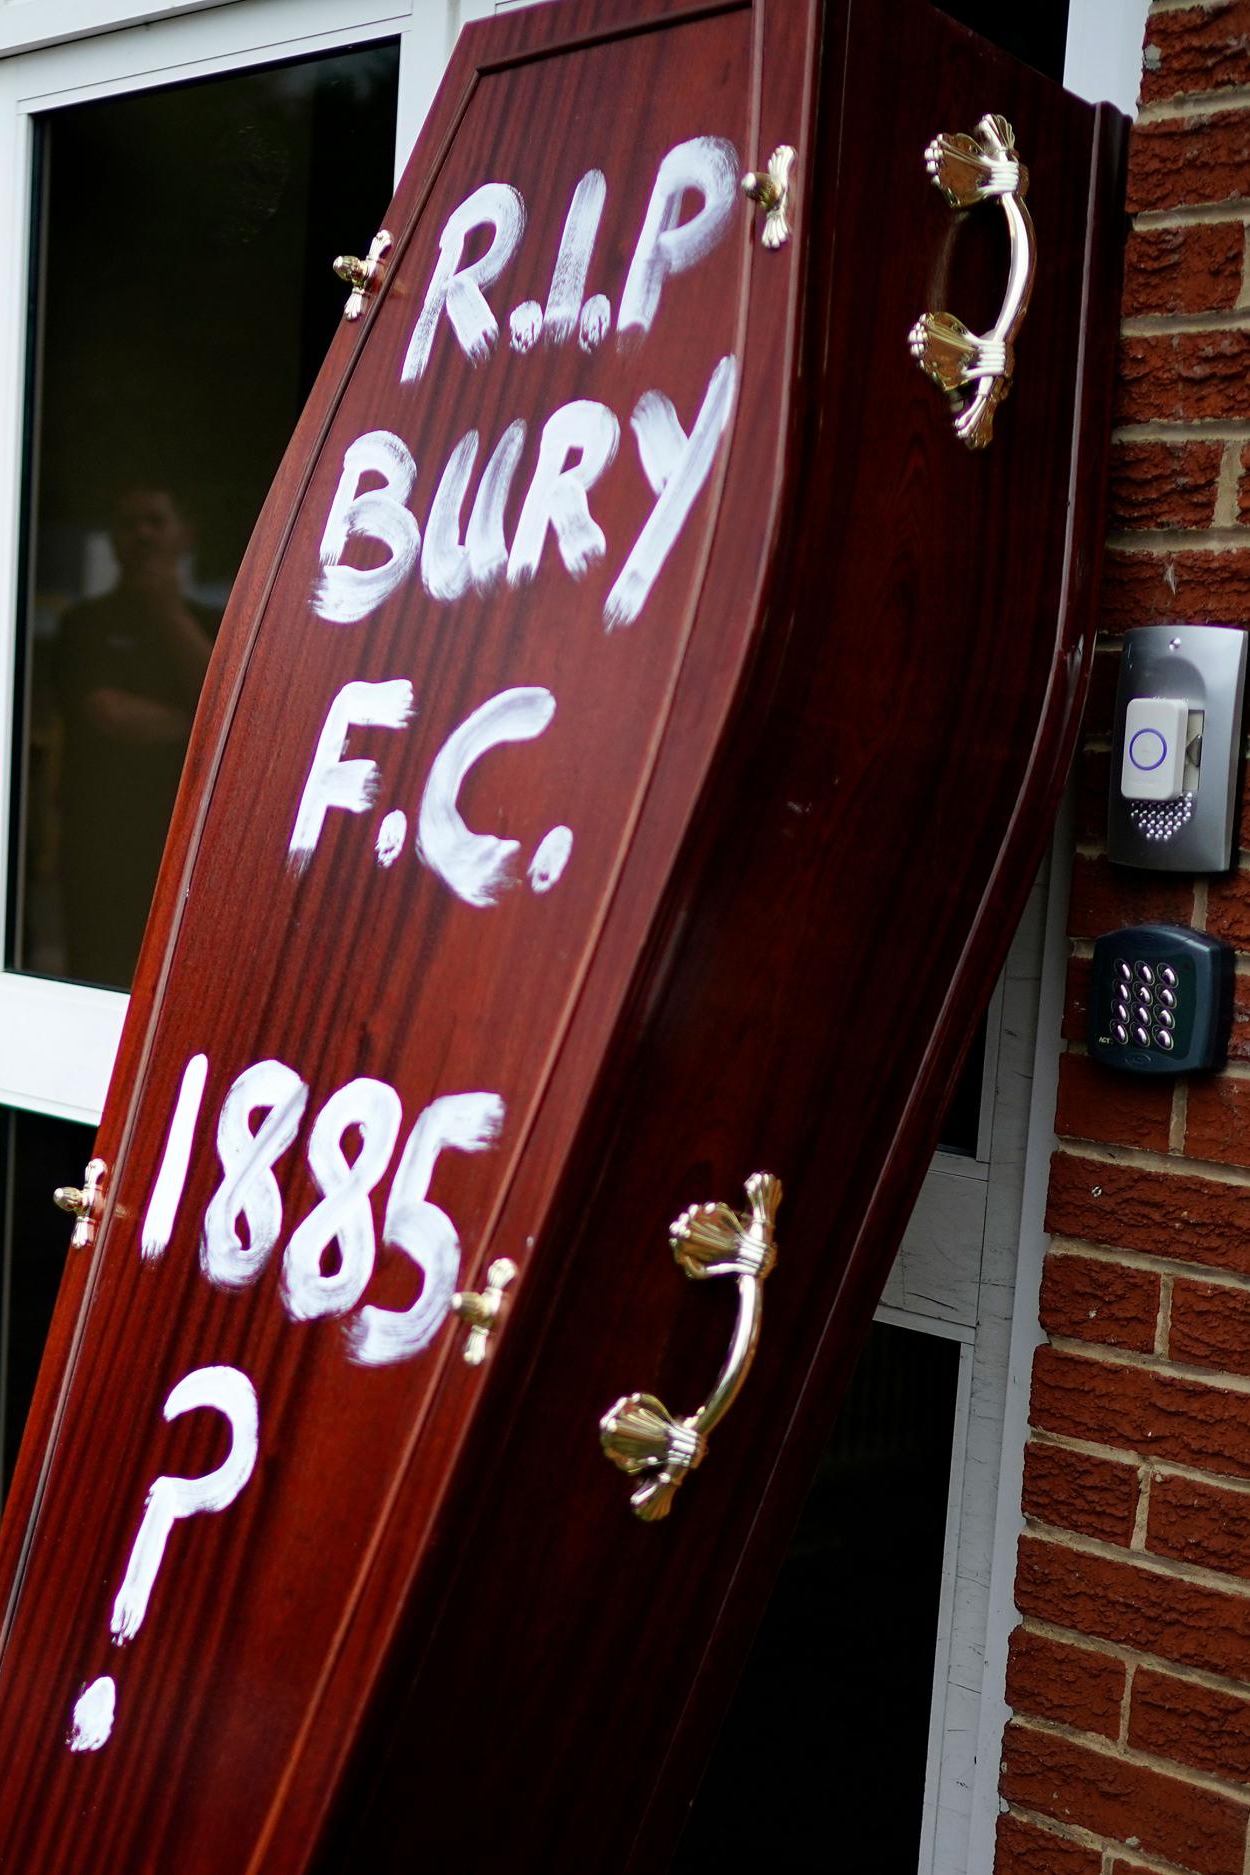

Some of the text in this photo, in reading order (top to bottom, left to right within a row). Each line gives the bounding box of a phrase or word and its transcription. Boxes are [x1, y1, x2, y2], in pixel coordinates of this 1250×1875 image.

[400, 135, 739, 385] R.I.P
[310, 352, 738, 634] BURY
[286, 678, 574, 908] F.C.
[141, 1053, 505, 1366] 1885
[65, 1365, 259, 1752] ?
